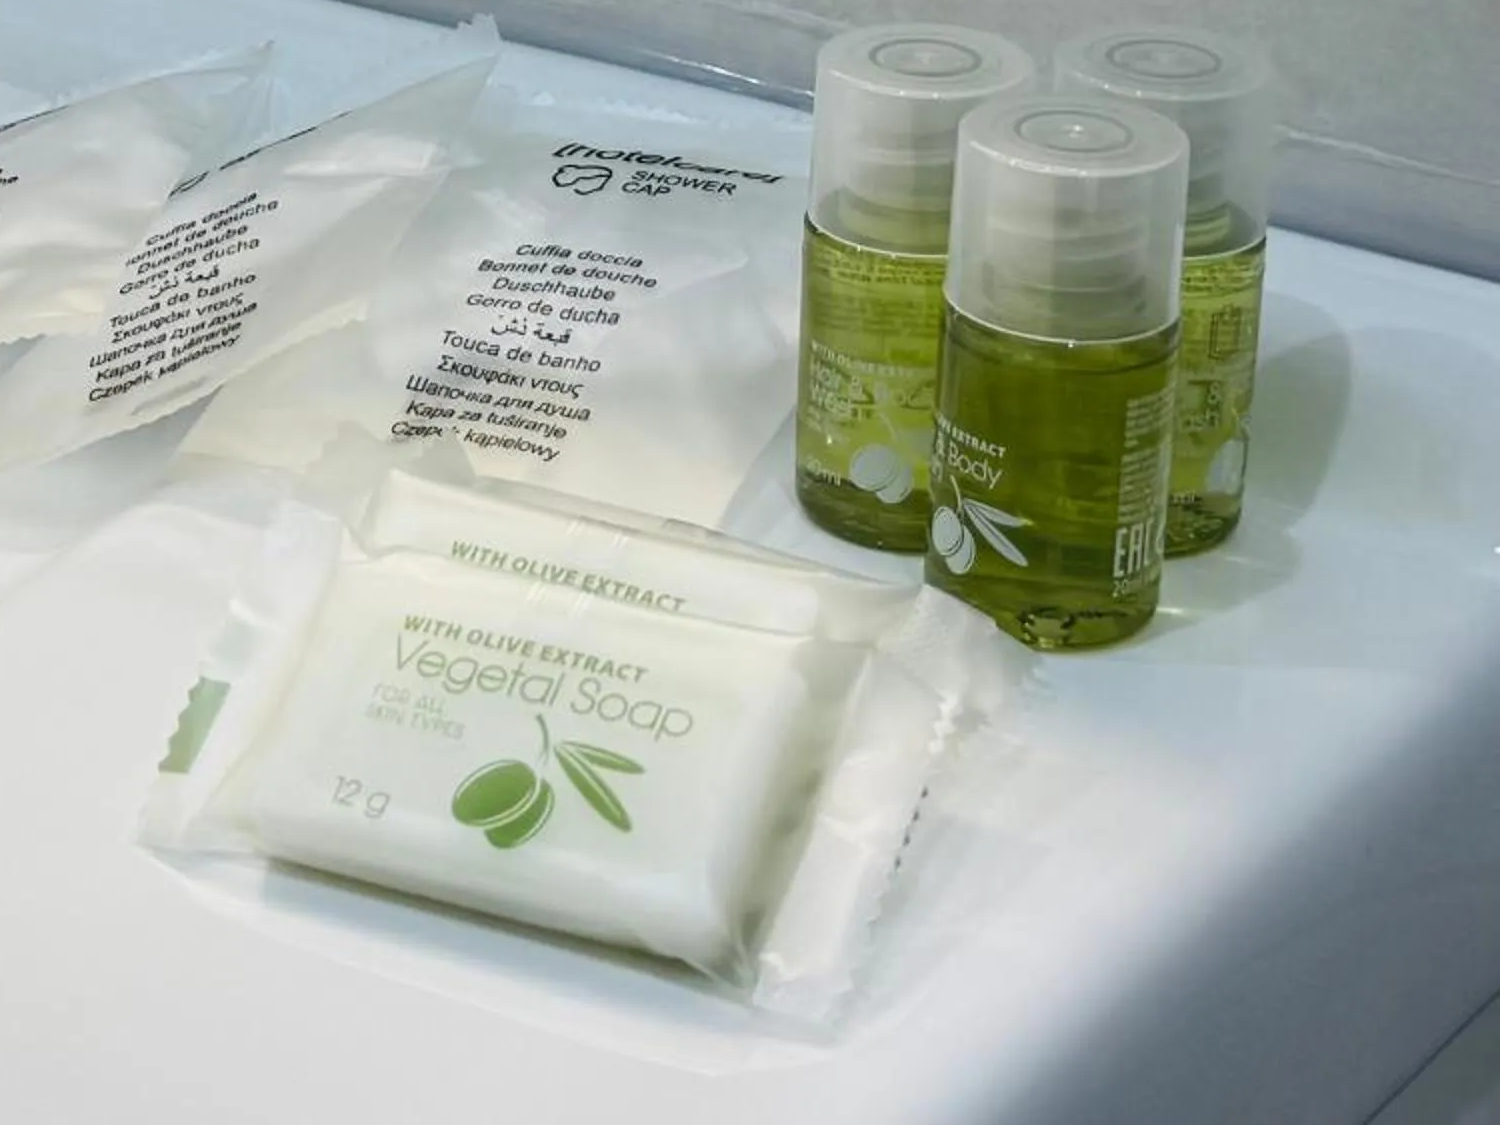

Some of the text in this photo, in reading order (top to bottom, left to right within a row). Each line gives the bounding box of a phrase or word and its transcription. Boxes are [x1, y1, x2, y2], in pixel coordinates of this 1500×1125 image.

[622, 182, 671, 197] CAP
[631, 170, 737, 195] SHOWER
[185, 229, 207, 243] de
[212, 200, 279, 232] douche
[137, 225, 249, 275] Duschhaube
[174, 259, 197, 272] de
[202, 238, 260, 262] ducha
[515, 244, 644, 269] Cuffia doccia
[477, 258, 658, 289] Bonnet de douche
[492, 276, 616, 302] Duschhaube
[109, 274, 257, 327] Touca de banho
[466, 293, 621, 326] Gorro de ducha
[95, 360, 141, 383] Kapa
[145, 350, 166, 366] za
[443, 330, 601, 373] Touca de banho
[89, 371, 152, 401] Czepek
[406, 374, 591, 421] Шапочка для душа
[406, 400, 455, 419] Kapa
[457, 410, 482, 421] za
[948, 439, 1003, 490] Body
[451, 541, 687, 612] WITH OLIVE EXTRACT
[404, 615, 649, 683] WITH OLIVE EXTRACT
[396, 631, 694, 741] Vegetal Soap
[333, 775, 391, 820] 12 g
